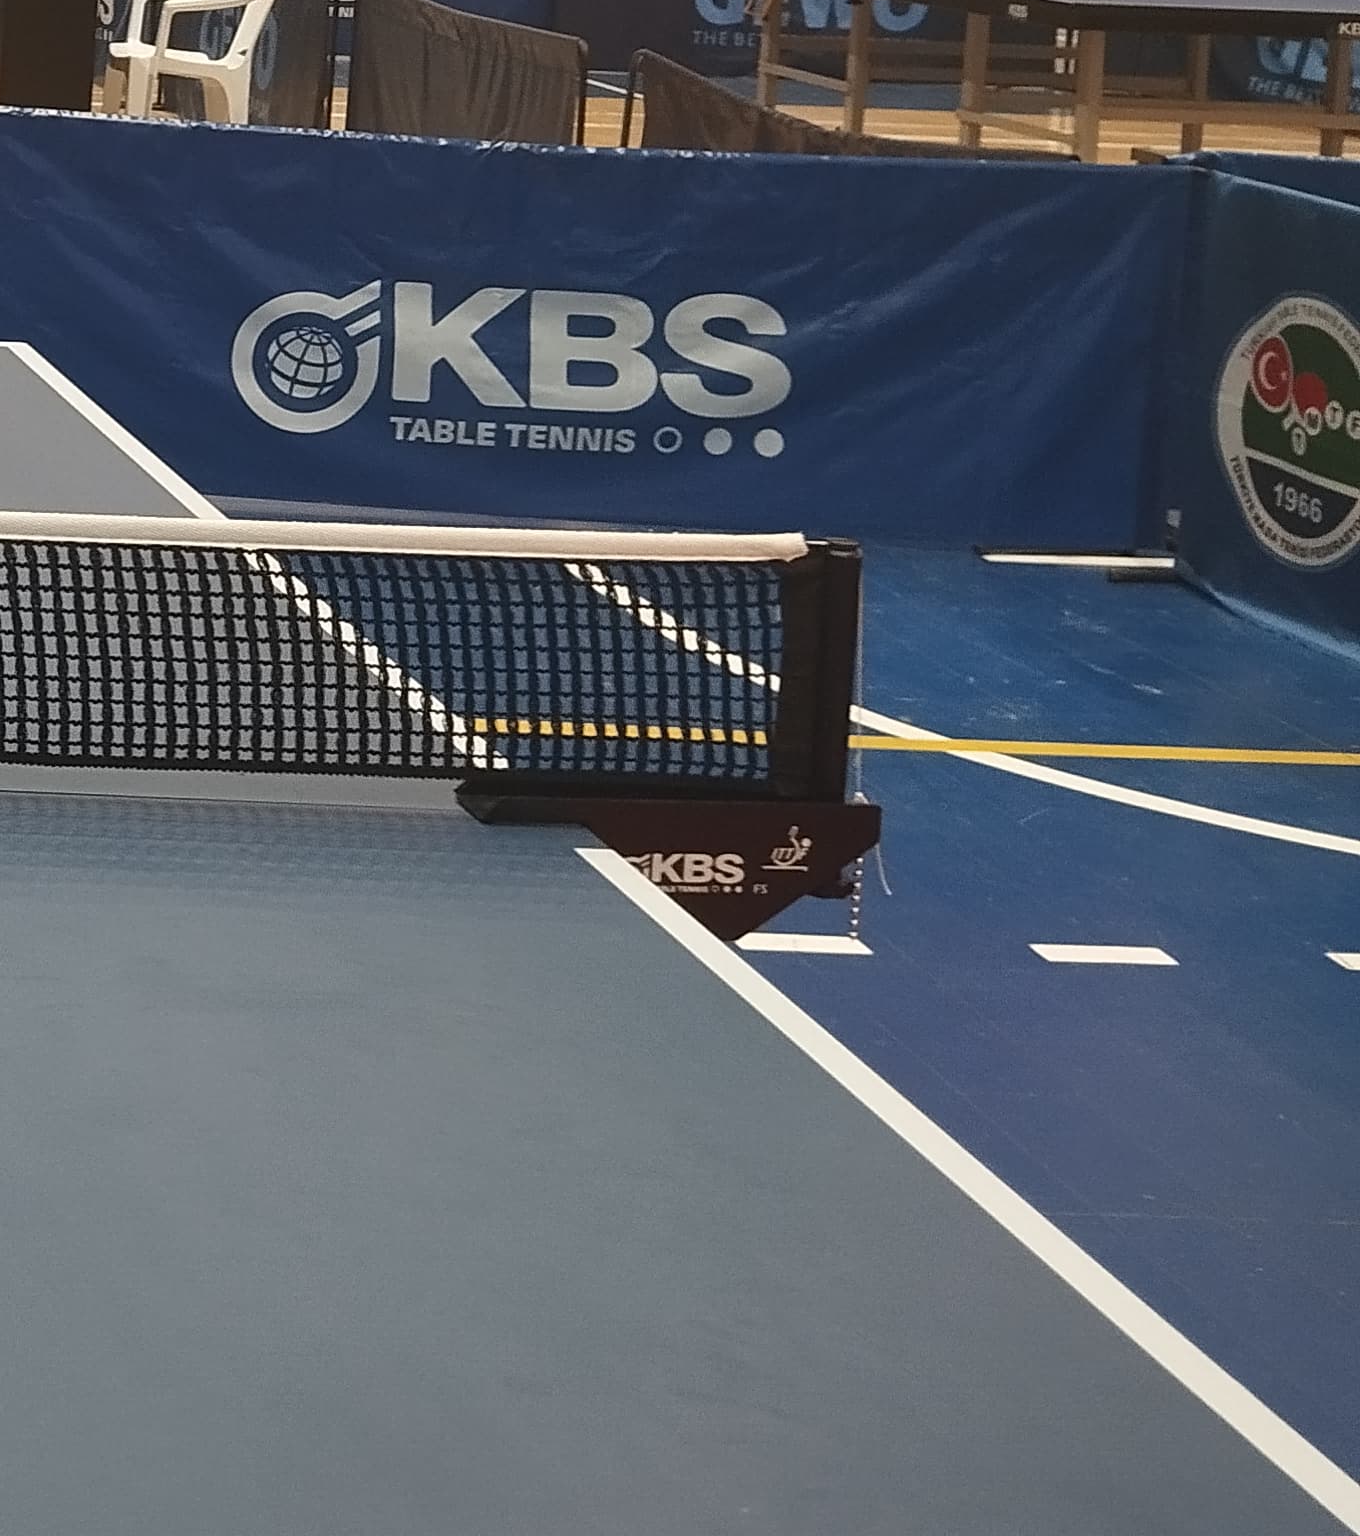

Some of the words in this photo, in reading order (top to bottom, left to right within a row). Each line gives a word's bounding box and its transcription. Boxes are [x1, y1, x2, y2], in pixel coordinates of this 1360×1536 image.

[392, 282, 792, 417] KBS
[390, 415, 496, 448] TABLE
[508, 421, 637, 454] TENNIS
[650, 852, 746, 885] KBS
